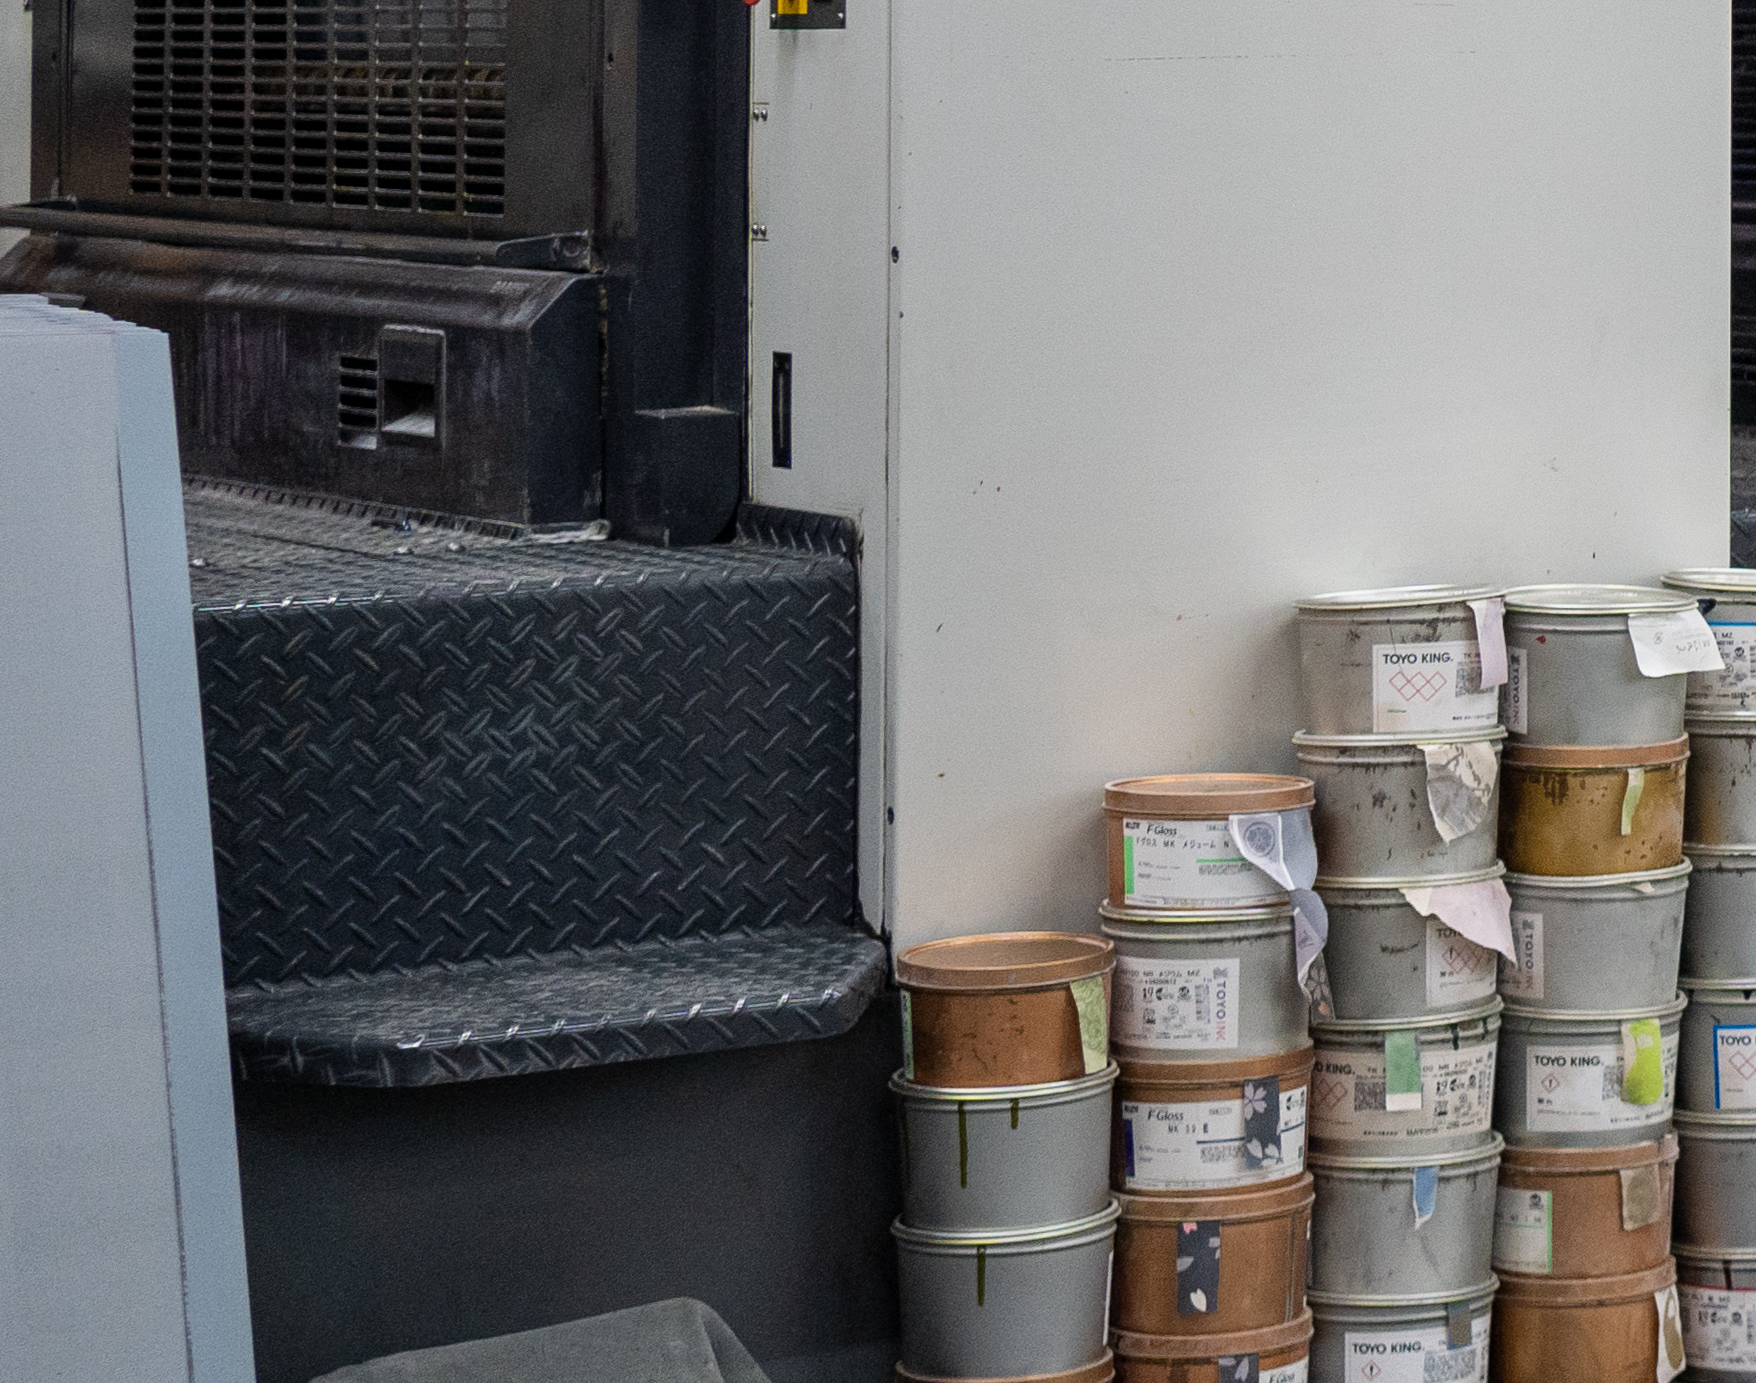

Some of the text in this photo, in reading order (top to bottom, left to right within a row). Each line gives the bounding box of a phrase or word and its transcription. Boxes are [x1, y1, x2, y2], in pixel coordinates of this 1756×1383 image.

[1383, 654, 1417, 664] TOYO
[1719, 1034, 1751, 1046] TOYO
[1534, 1055, 1566, 1066] TOYO
[1353, 1343, 1387, 1354] TOYO
